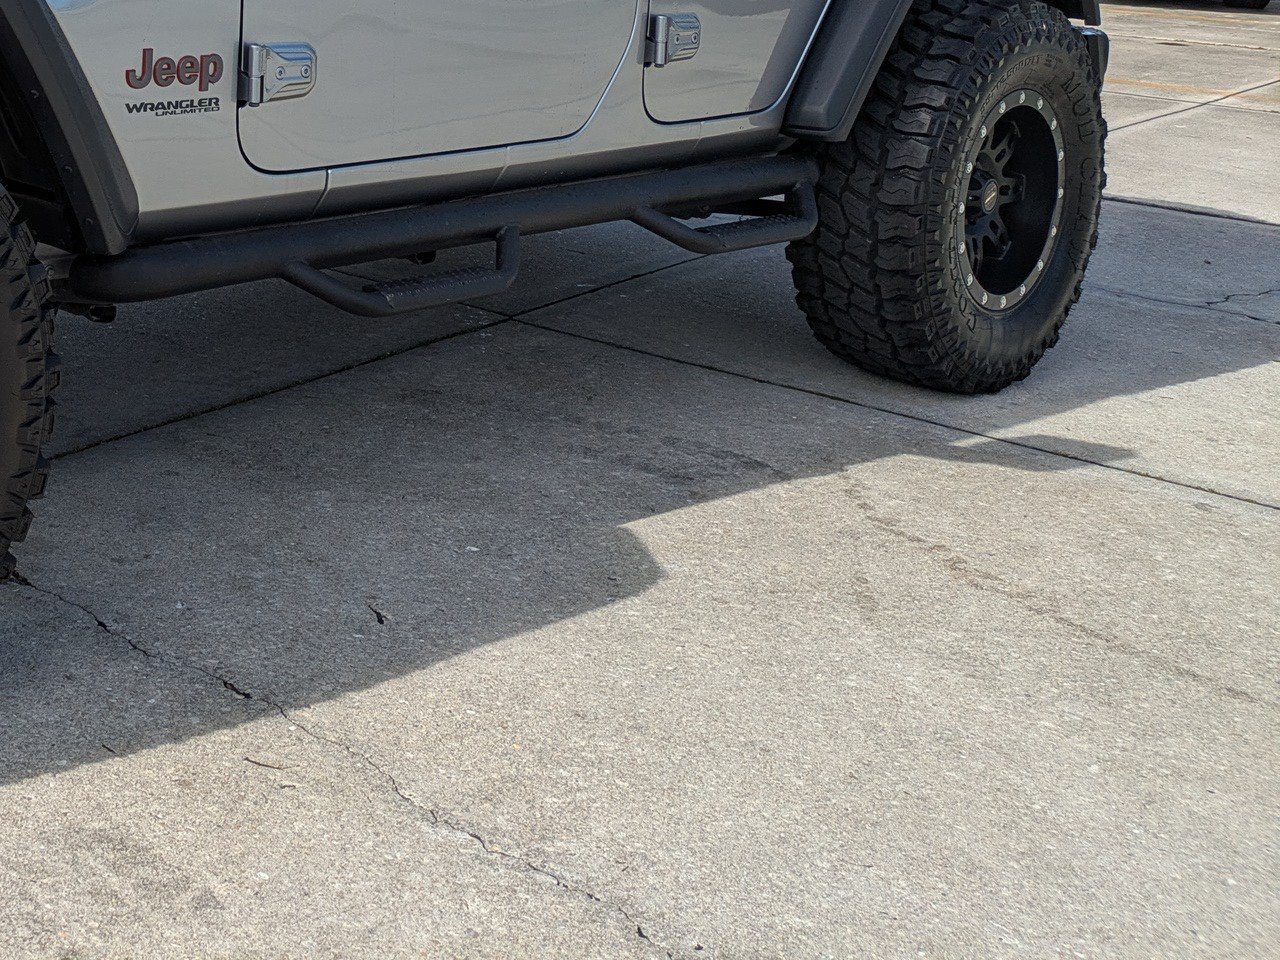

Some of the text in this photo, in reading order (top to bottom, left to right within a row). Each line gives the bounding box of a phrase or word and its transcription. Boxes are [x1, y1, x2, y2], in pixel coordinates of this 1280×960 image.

[125, 47, 224, 92] Jeep
[125, 97, 220, 114] WRANGLER
[155, 106, 220, 117] UNLIMITED
